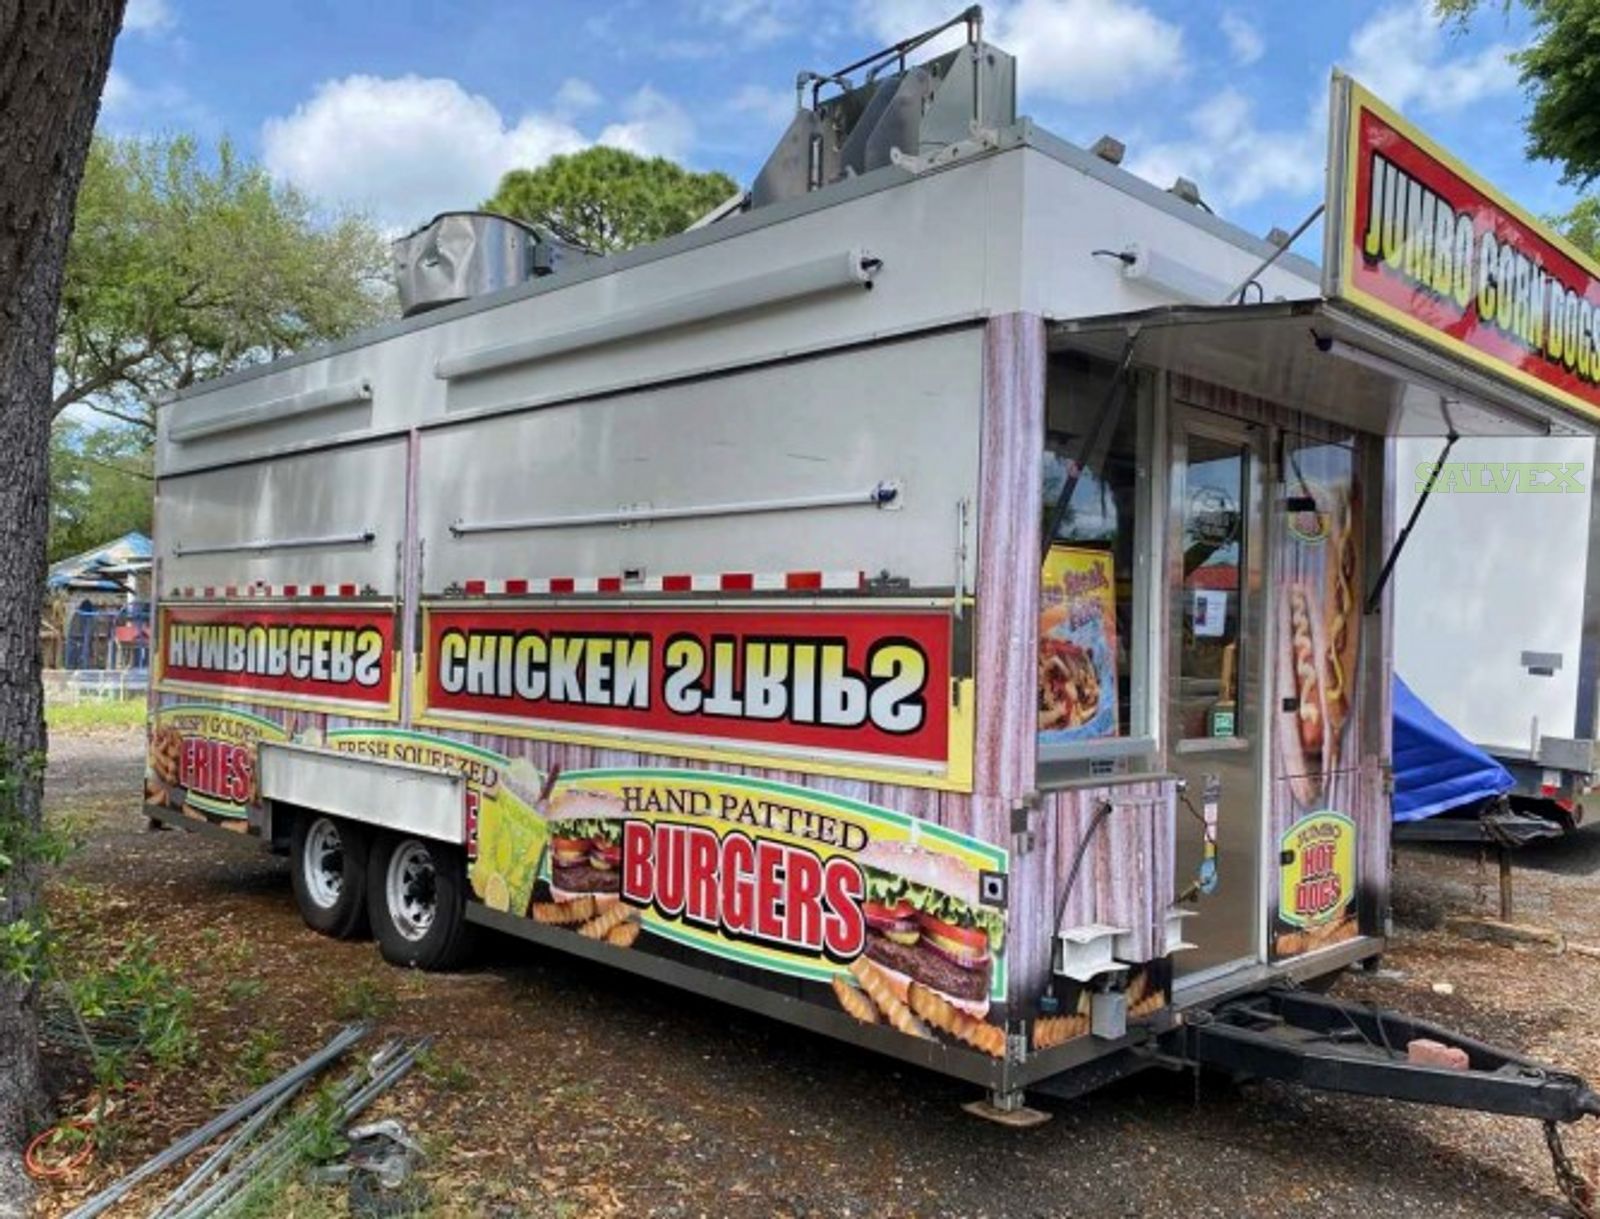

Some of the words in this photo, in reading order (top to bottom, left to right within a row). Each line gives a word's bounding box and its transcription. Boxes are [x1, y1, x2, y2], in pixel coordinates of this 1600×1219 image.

[1363, 150, 1476, 308] JUMBO
[1476, 230, 1546, 355] CORN
[180, 737, 251, 805] FRIES
[622, 786, 711, 818] HAND
[719, 793, 869, 853] PATTIED
[620, 820, 867, 962] BURGERS
[1302, 840, 1337, 880] HOT
[1294, 873, 1342, 916] DOGS
